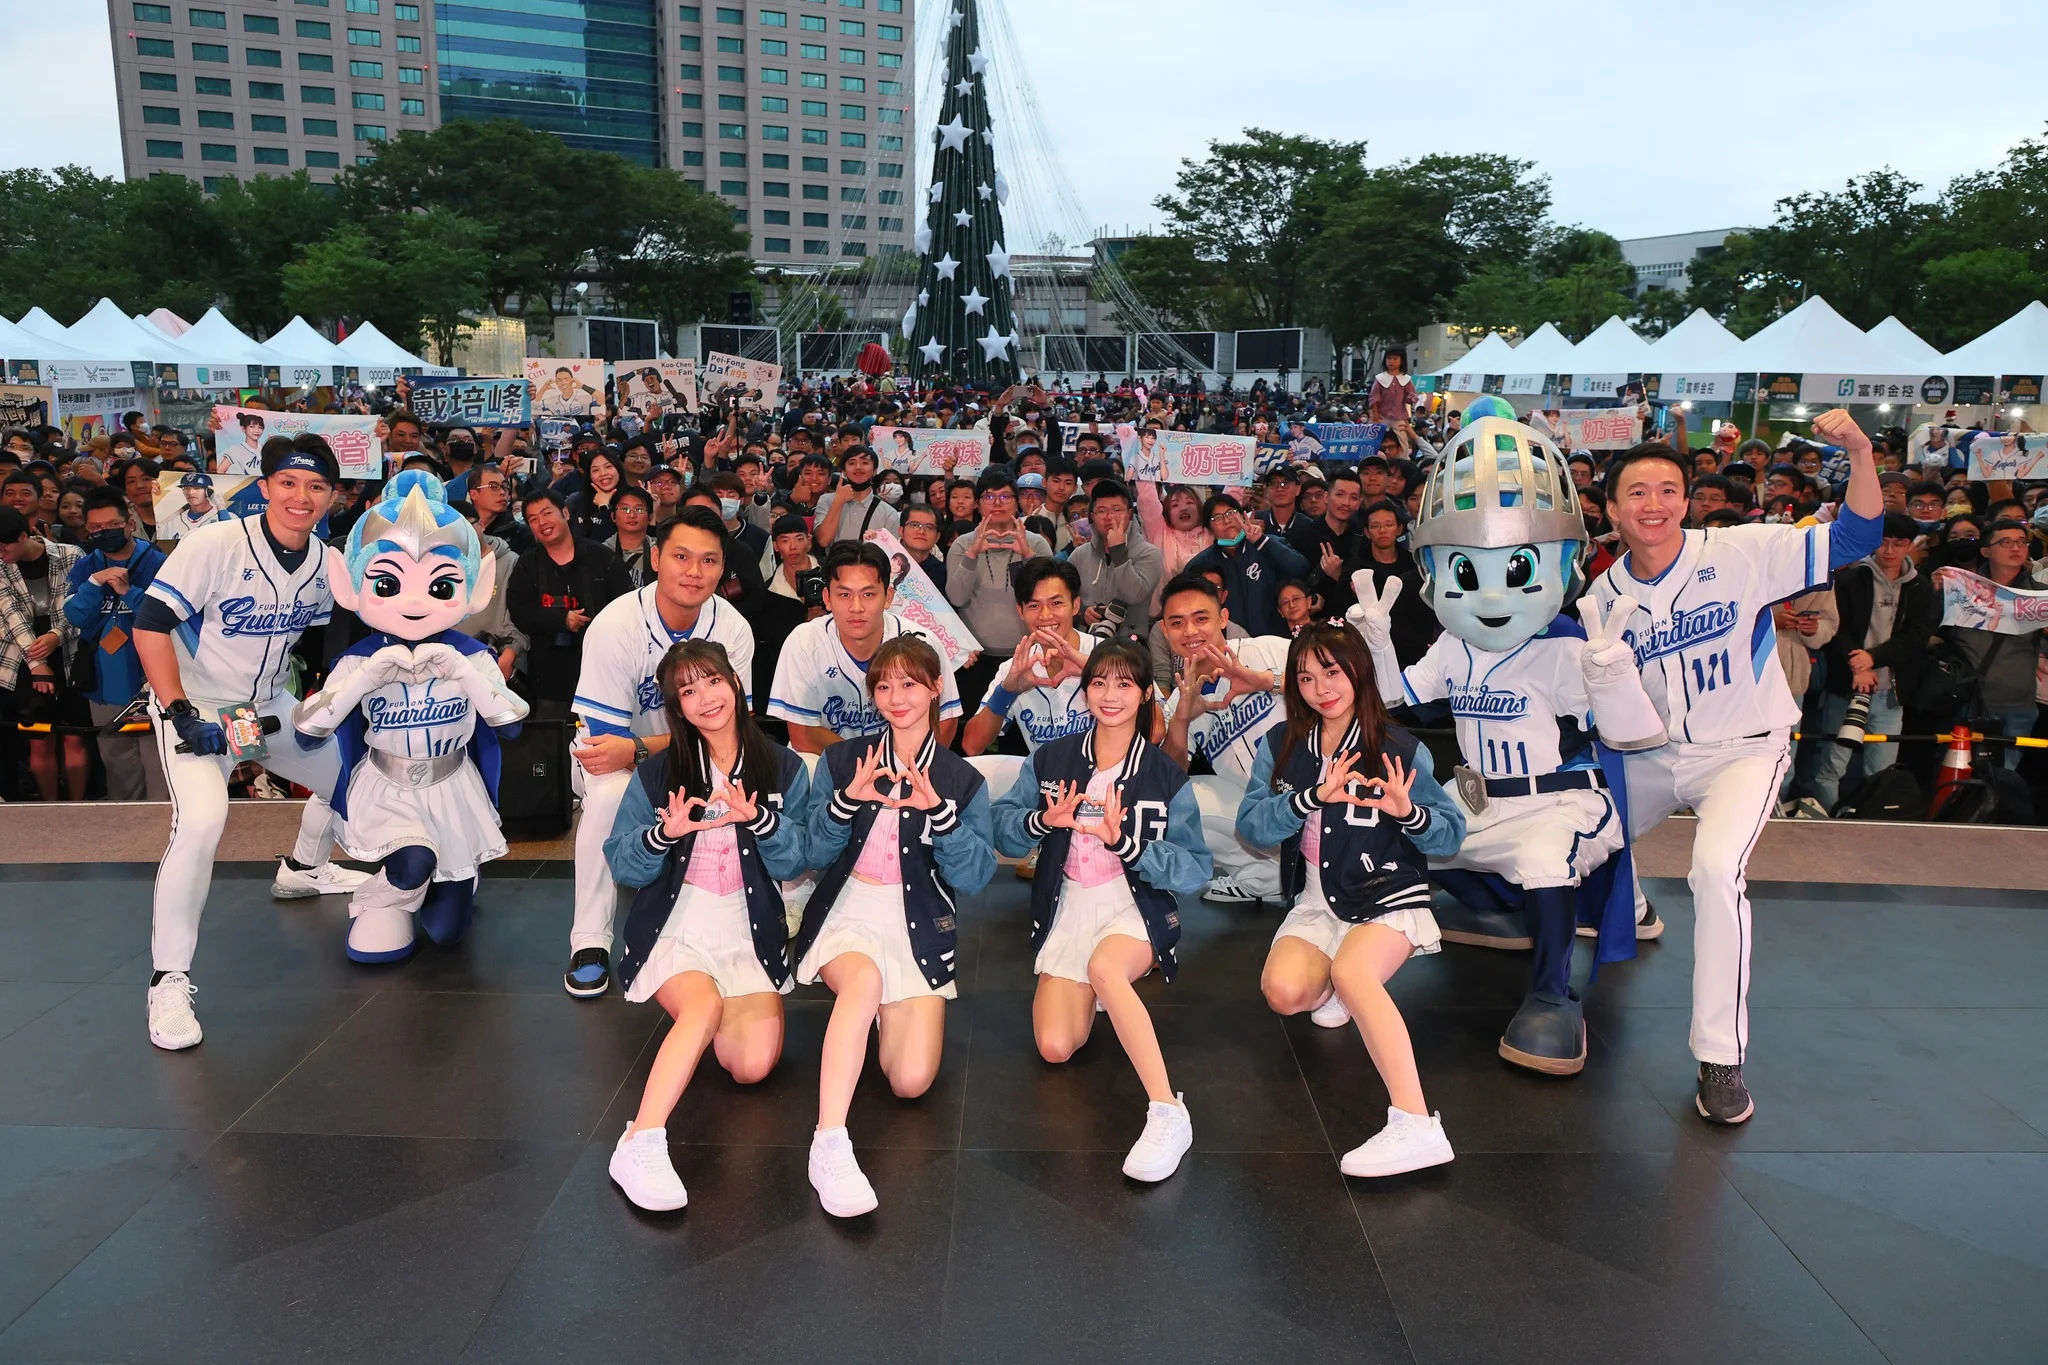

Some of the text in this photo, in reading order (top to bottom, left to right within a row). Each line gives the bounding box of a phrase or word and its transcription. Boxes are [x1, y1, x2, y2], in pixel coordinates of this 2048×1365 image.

[711, 354, 746, 369] Pei-Fong
[528, 369, 547, 380] CUTE
[729, 369, 748, 380] #95
[1858, 384, 1915, 398] 富邦金控
[412, 383, 523, 423] 戴培峰
[502, 408, 523, 424] 95
[1319, 423, 1382, 440] Travis
[1581, 416, 1634, 444] 奶昔
[290, 457, 316, 467] Travis
[1181, 442, 1246, 477] 奶昔
[1692, 648, 1731, 695] 111
[368, 696, 469, 732] Guardians
[1487, 739, 1529, 774] 111
